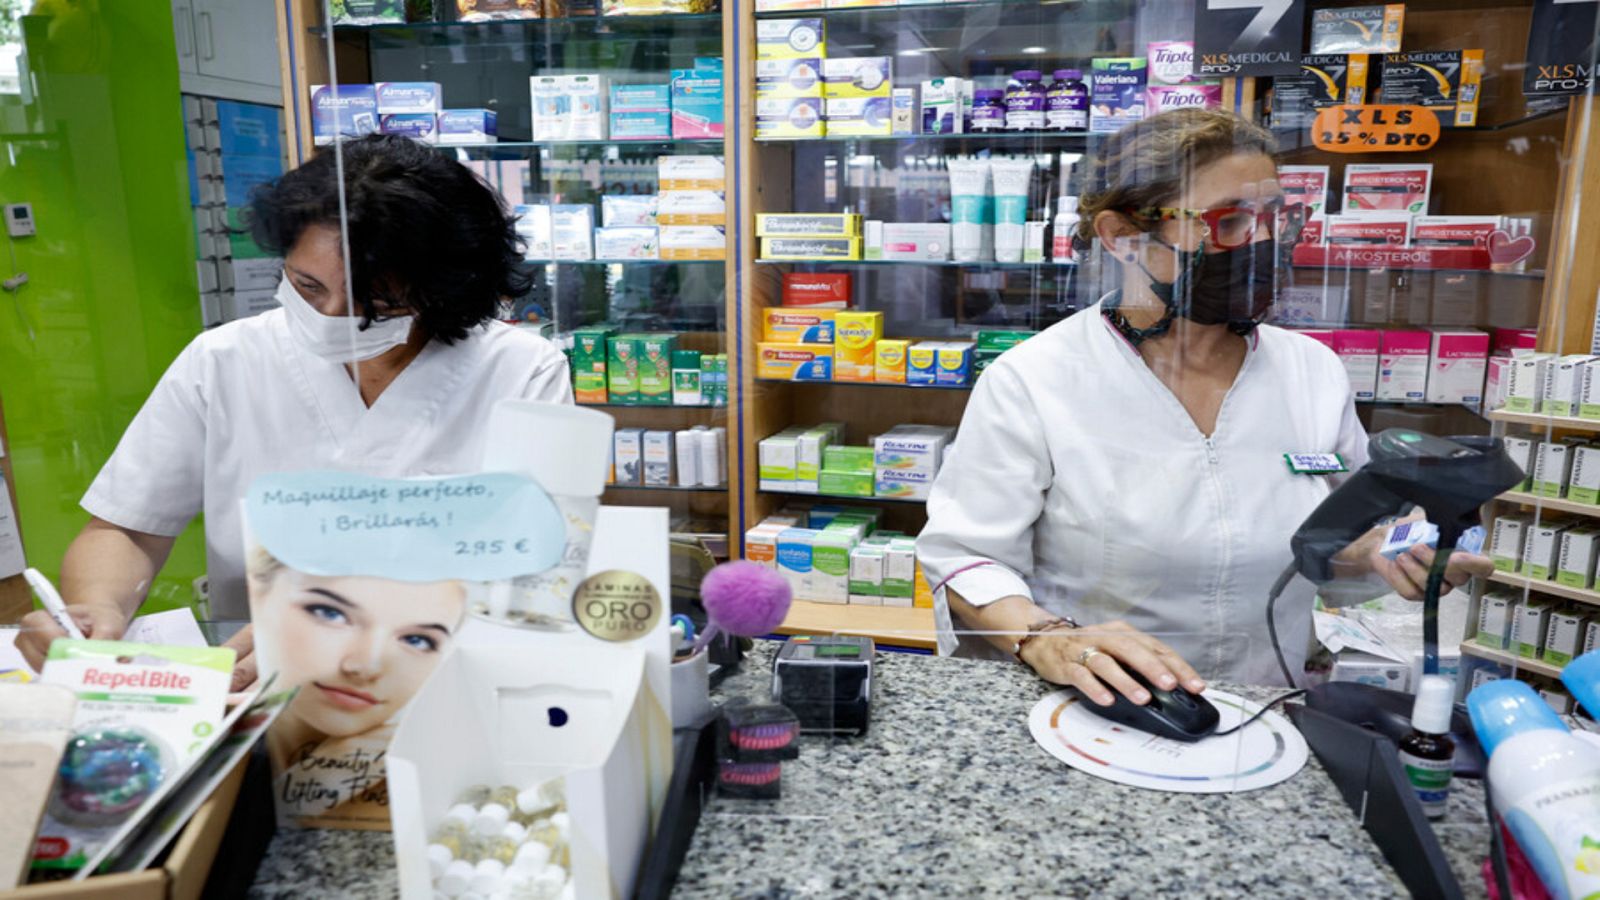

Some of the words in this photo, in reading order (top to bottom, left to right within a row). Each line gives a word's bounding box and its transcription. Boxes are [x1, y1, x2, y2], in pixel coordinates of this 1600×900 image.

[1202, 52, 1293, 64] XLSMEDICAL
[1094, 75, 1138, 85] Valeriana
[1161, 90, 1206, 106] Tripto
[1384, 132, 1431, 146] DTO
[1335, 250, 1431, 264] ARKOSTEROL
[262, 486, 390, 506] Maquillaje
[585, 600, 652, 621] ORO
[593, 620, 647, 632] PURO
[83, 668, 192, 690] RepelBite
